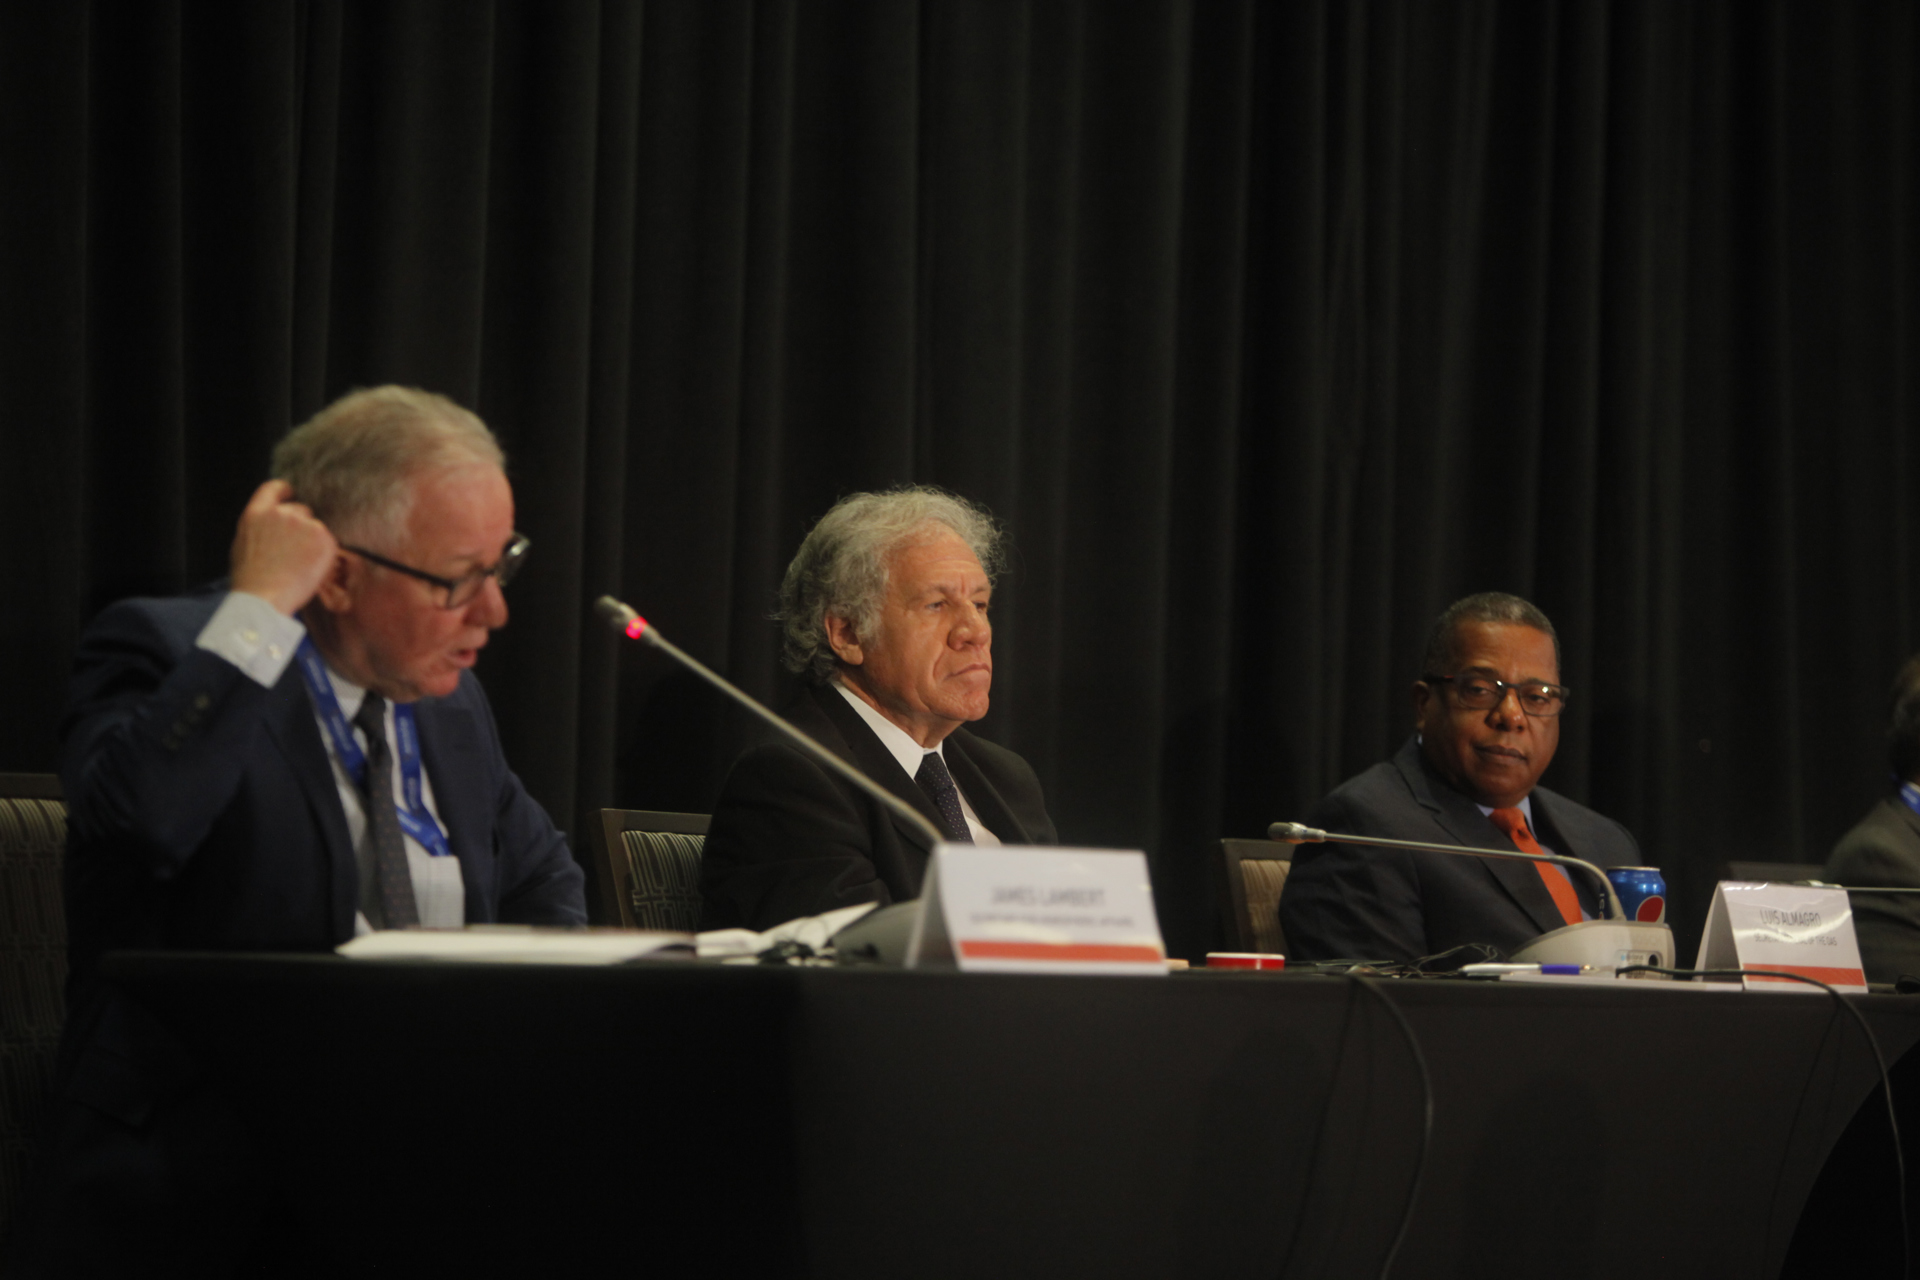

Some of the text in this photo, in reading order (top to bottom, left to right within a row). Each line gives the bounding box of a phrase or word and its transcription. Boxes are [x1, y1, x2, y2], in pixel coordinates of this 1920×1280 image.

[991, 886, 1105, 908] JAMES LAMBERT
[1759, 909, 1822, 927] LUIS ALMAGRO
